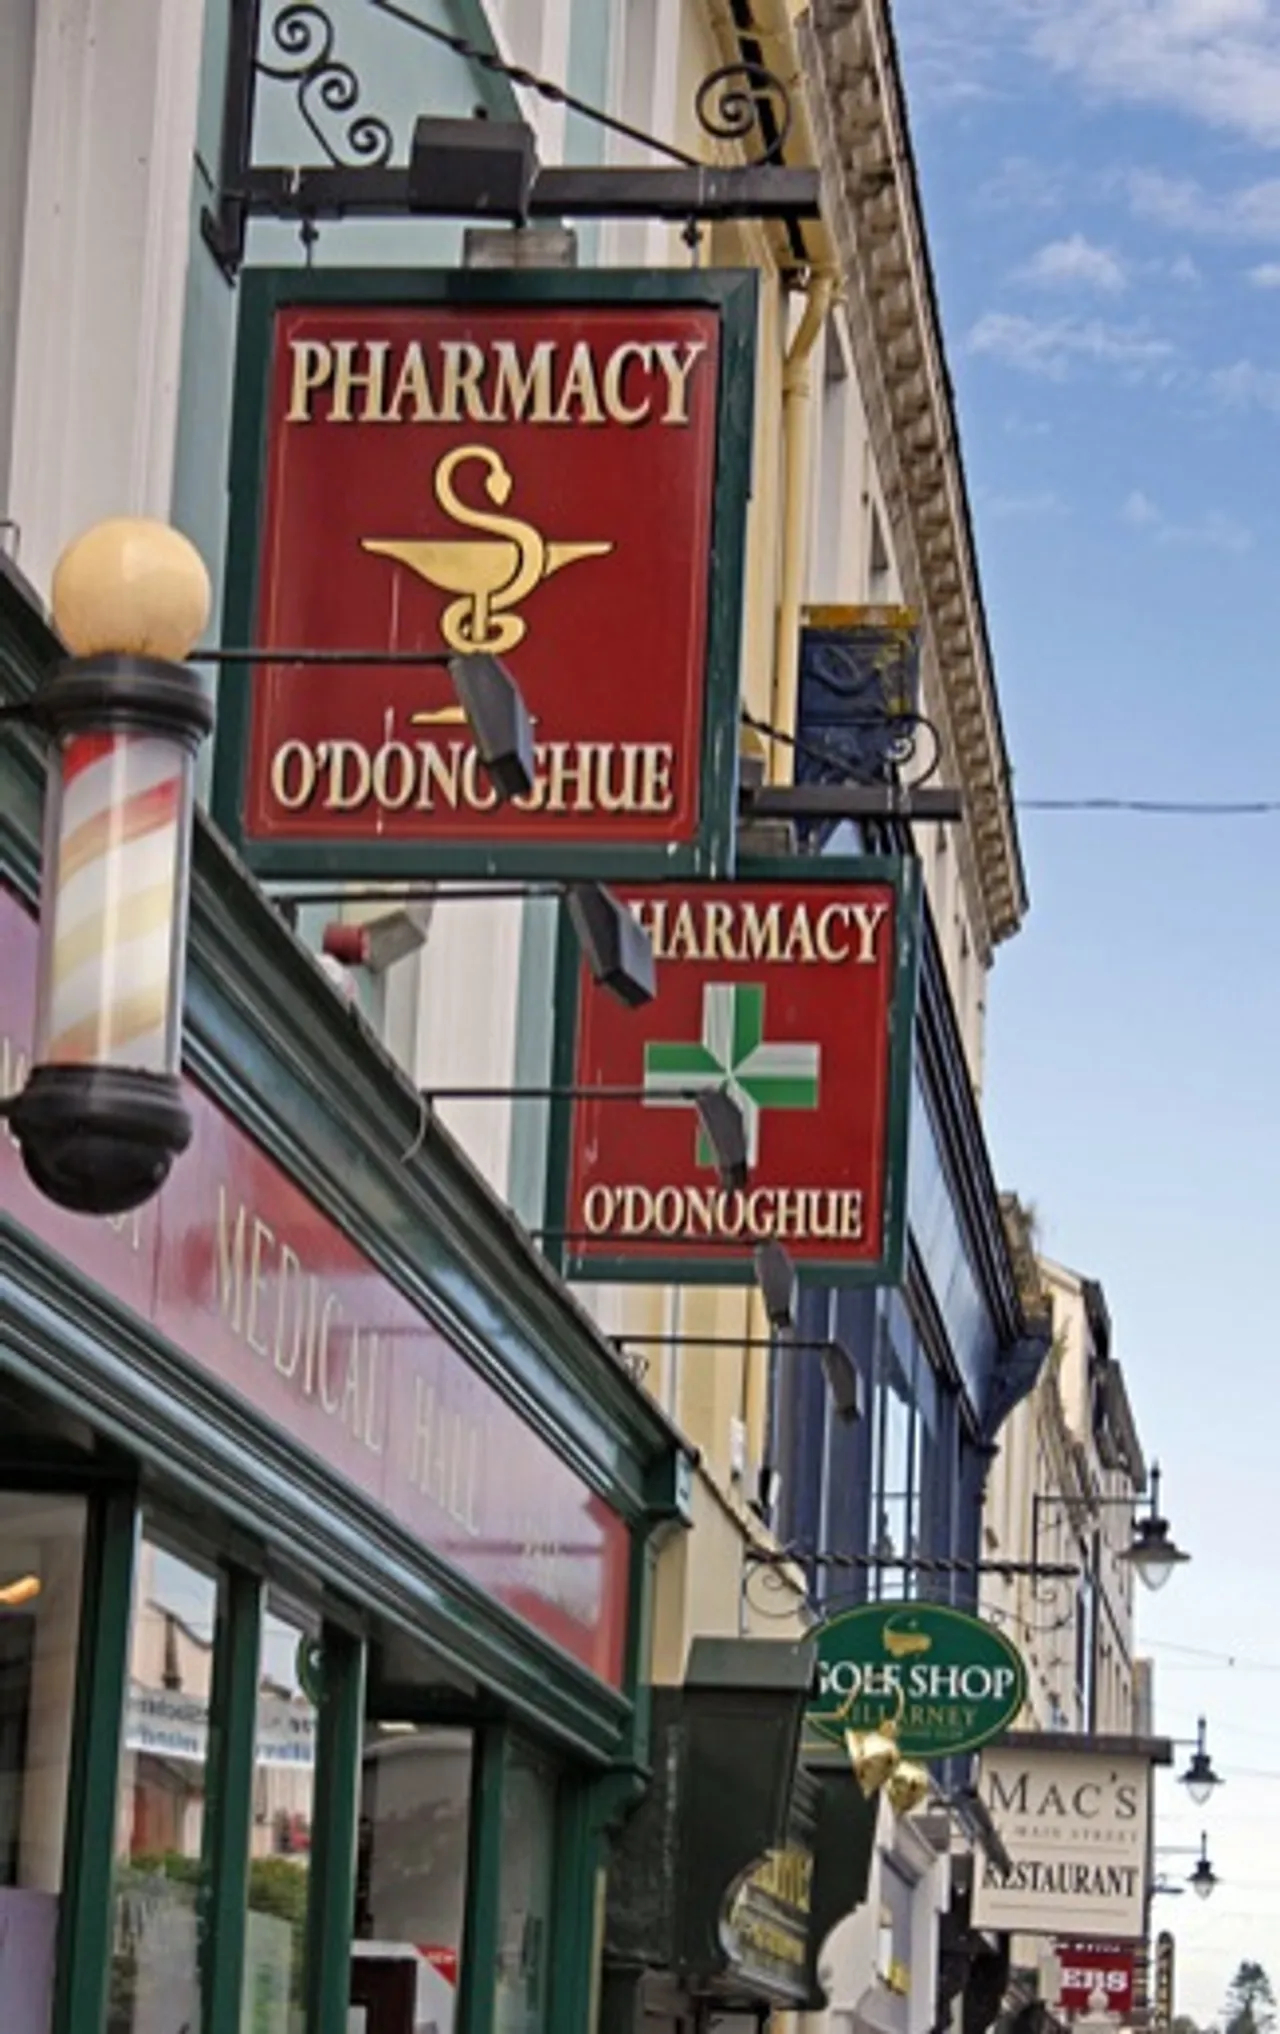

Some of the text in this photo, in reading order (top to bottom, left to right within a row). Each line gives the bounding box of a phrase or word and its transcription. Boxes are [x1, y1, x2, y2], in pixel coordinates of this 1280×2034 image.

[285, 340, 706, 423] PHARMACY
[628, 898, 888, 963] HARMACY
[583, 1184, 863, 1239] O'DONOGHUE
[212, 1184, 482, 1536] MEDICAL HALL
[908, 1663, 1016, 1700] SHOP
